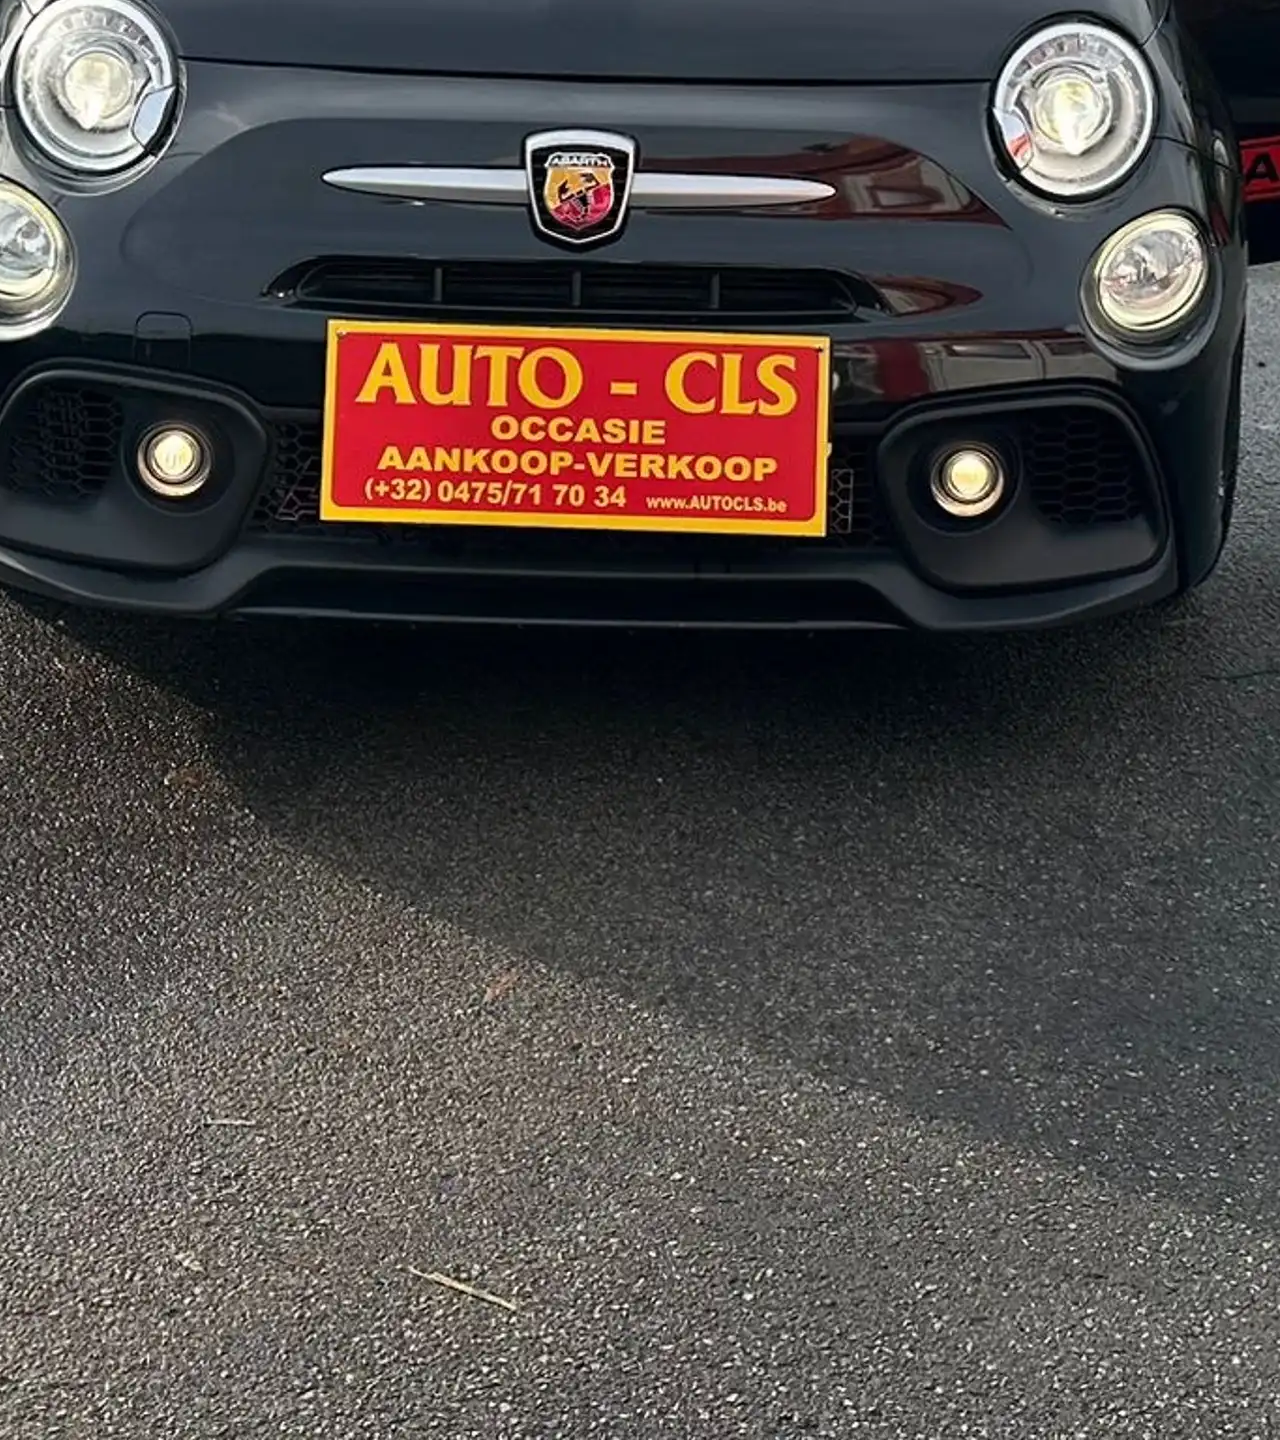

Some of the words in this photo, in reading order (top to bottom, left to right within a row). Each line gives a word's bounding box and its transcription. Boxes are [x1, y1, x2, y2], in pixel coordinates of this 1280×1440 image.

[355, 342, 583, 409] AUTO
[609, 381, 638, 396] -
[663, 352, 798, 416] CLS
[490, 415, 666, 446] OCCASIE
[377, 446, 778, 482] AANKOOP-VERKOOP
[365, 477, 432, 503] (+32)
[437, 479, 542, 506] 0475/71
[553, 483, 586, 506] 70
[593, 484, 627, 508] 34
[646, 494, 788, 513] www.AUTOCLS.be
